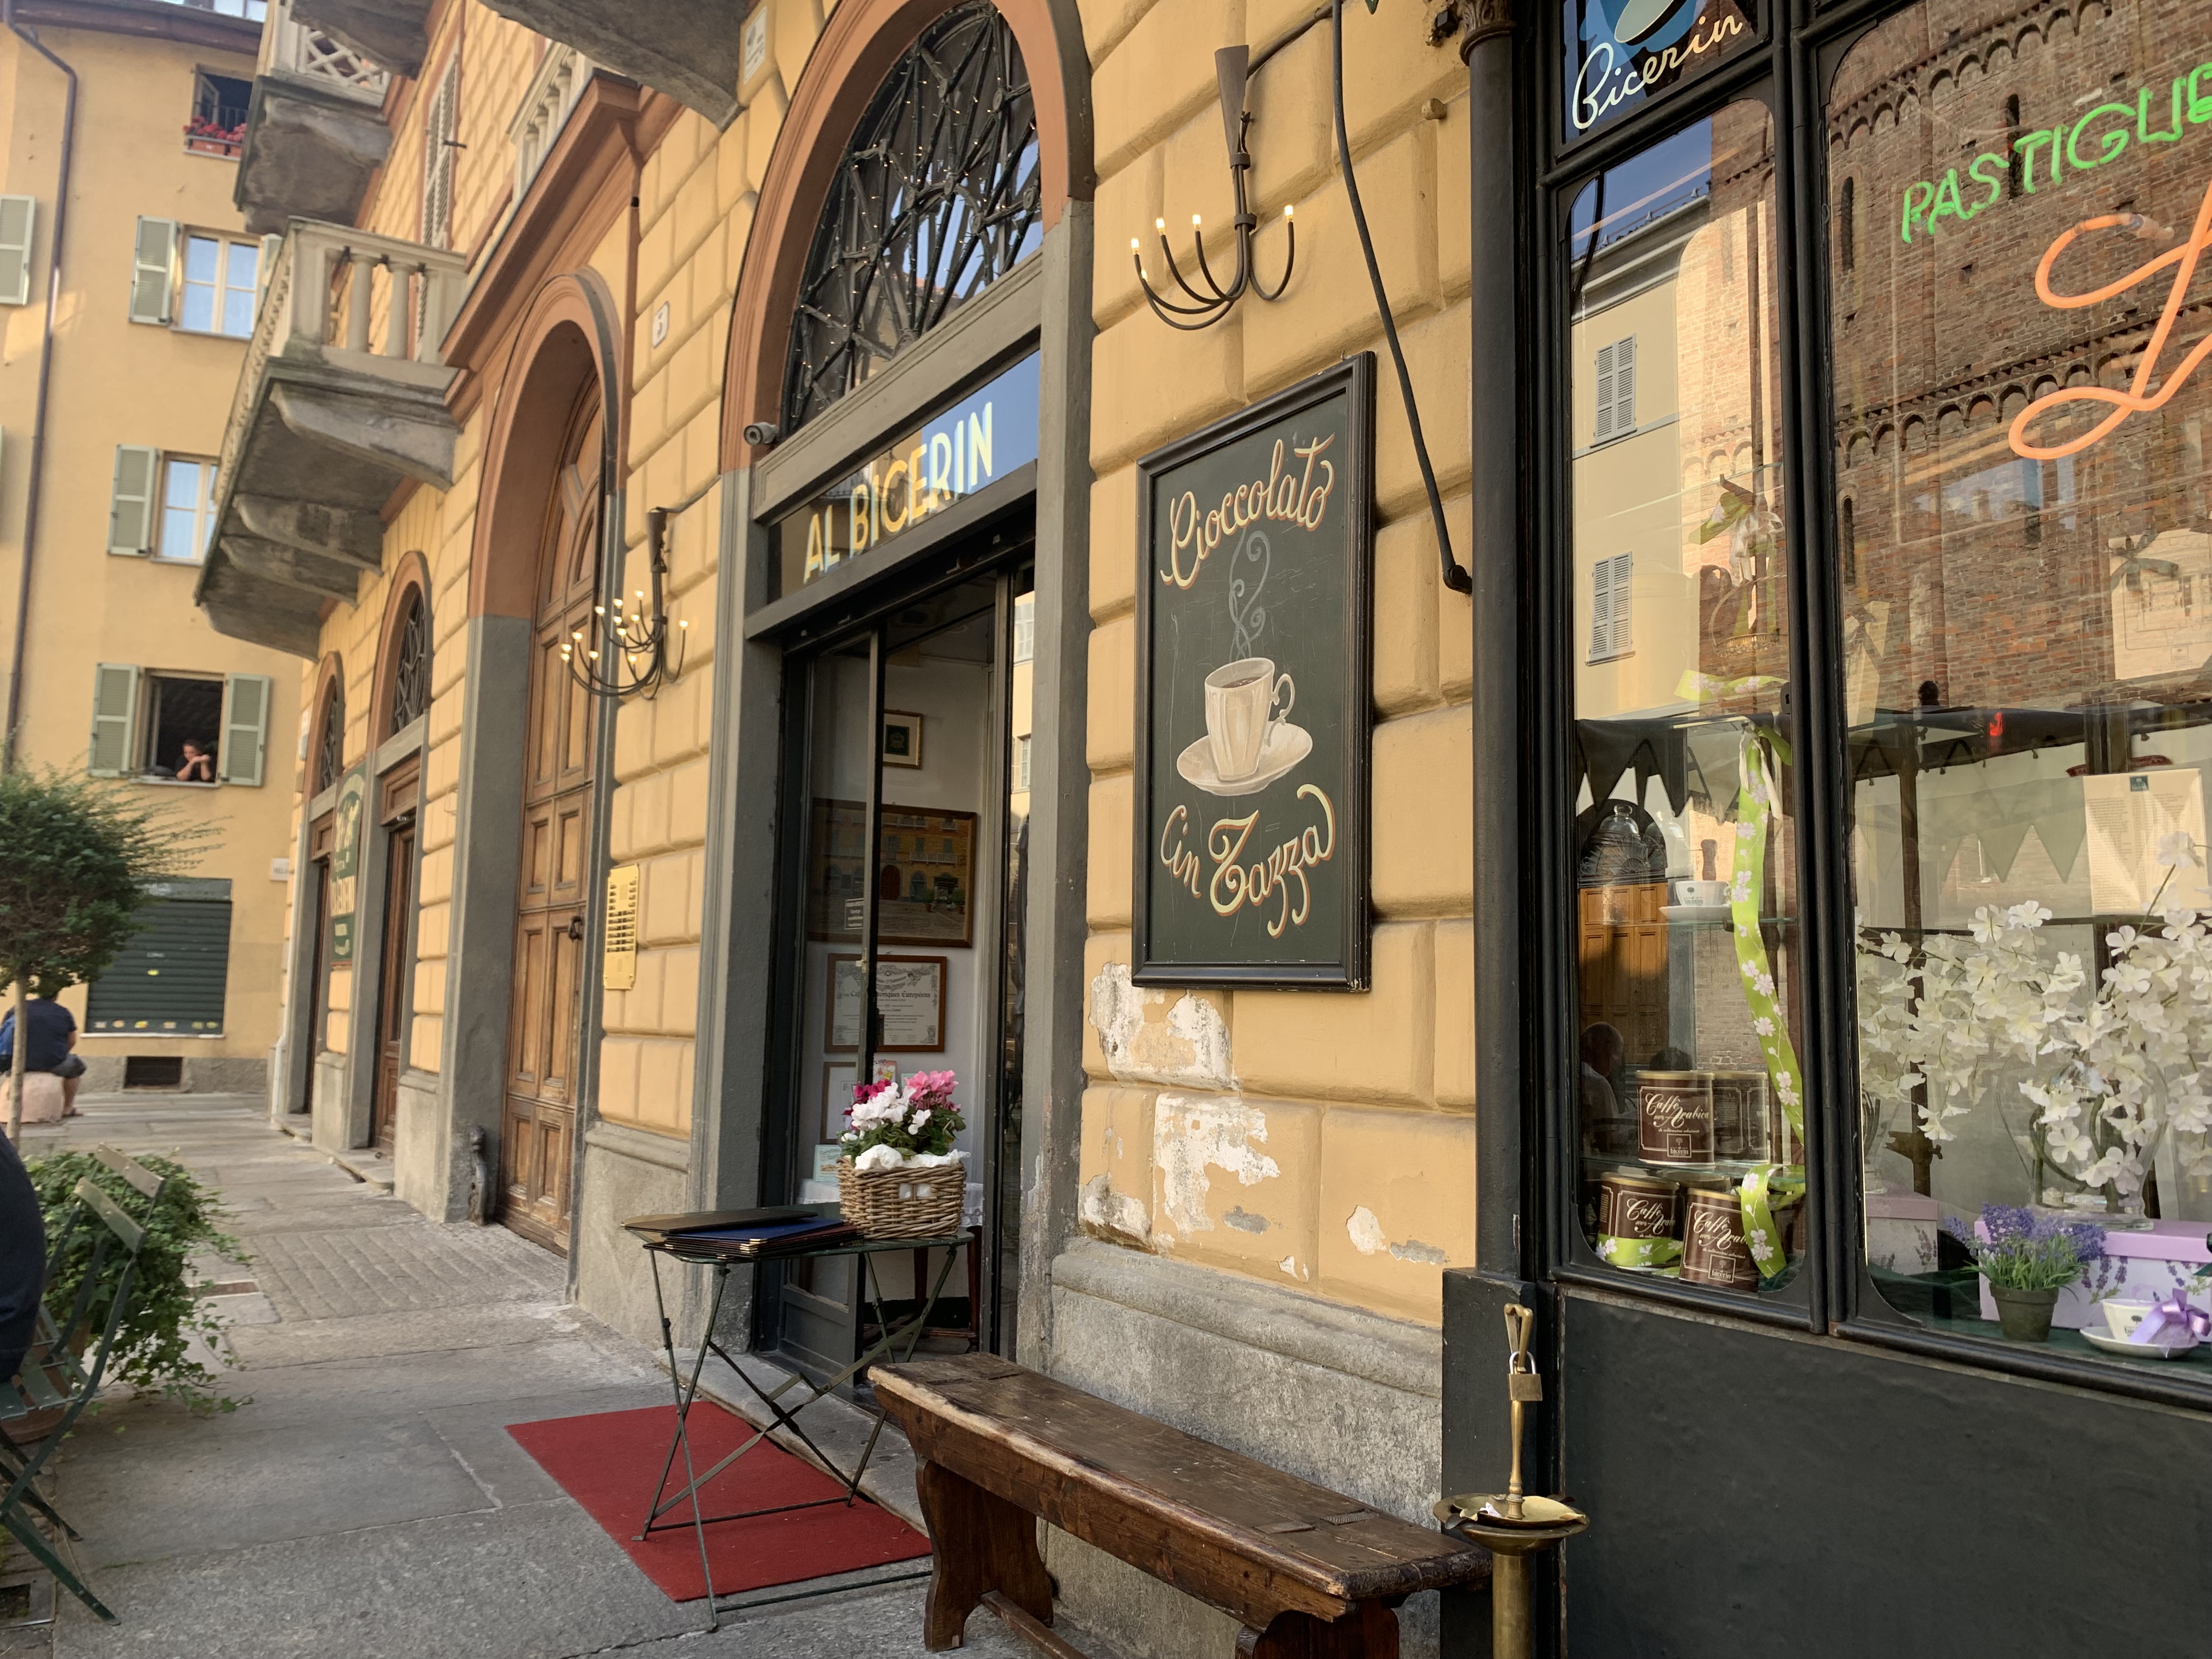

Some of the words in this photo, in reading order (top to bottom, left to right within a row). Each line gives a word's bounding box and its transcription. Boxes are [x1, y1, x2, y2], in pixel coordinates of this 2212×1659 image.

[1572, 14, 1743, 129] Bicerin
[803, 505, 840, 585] AL
[849, 401, 992, 560] BICERIN
[1160, 431, 1336, 590] Cioccolato
[1208, 783, 1336, 939] Tazza
[1645, 1093, 1681, 1115] Caffè
[1653, 1104, 1709, 1128] Arabica
[1627, 1198, 1663, 1220] Caffè
[1693, 1210, 1730, 1233] Caffè
